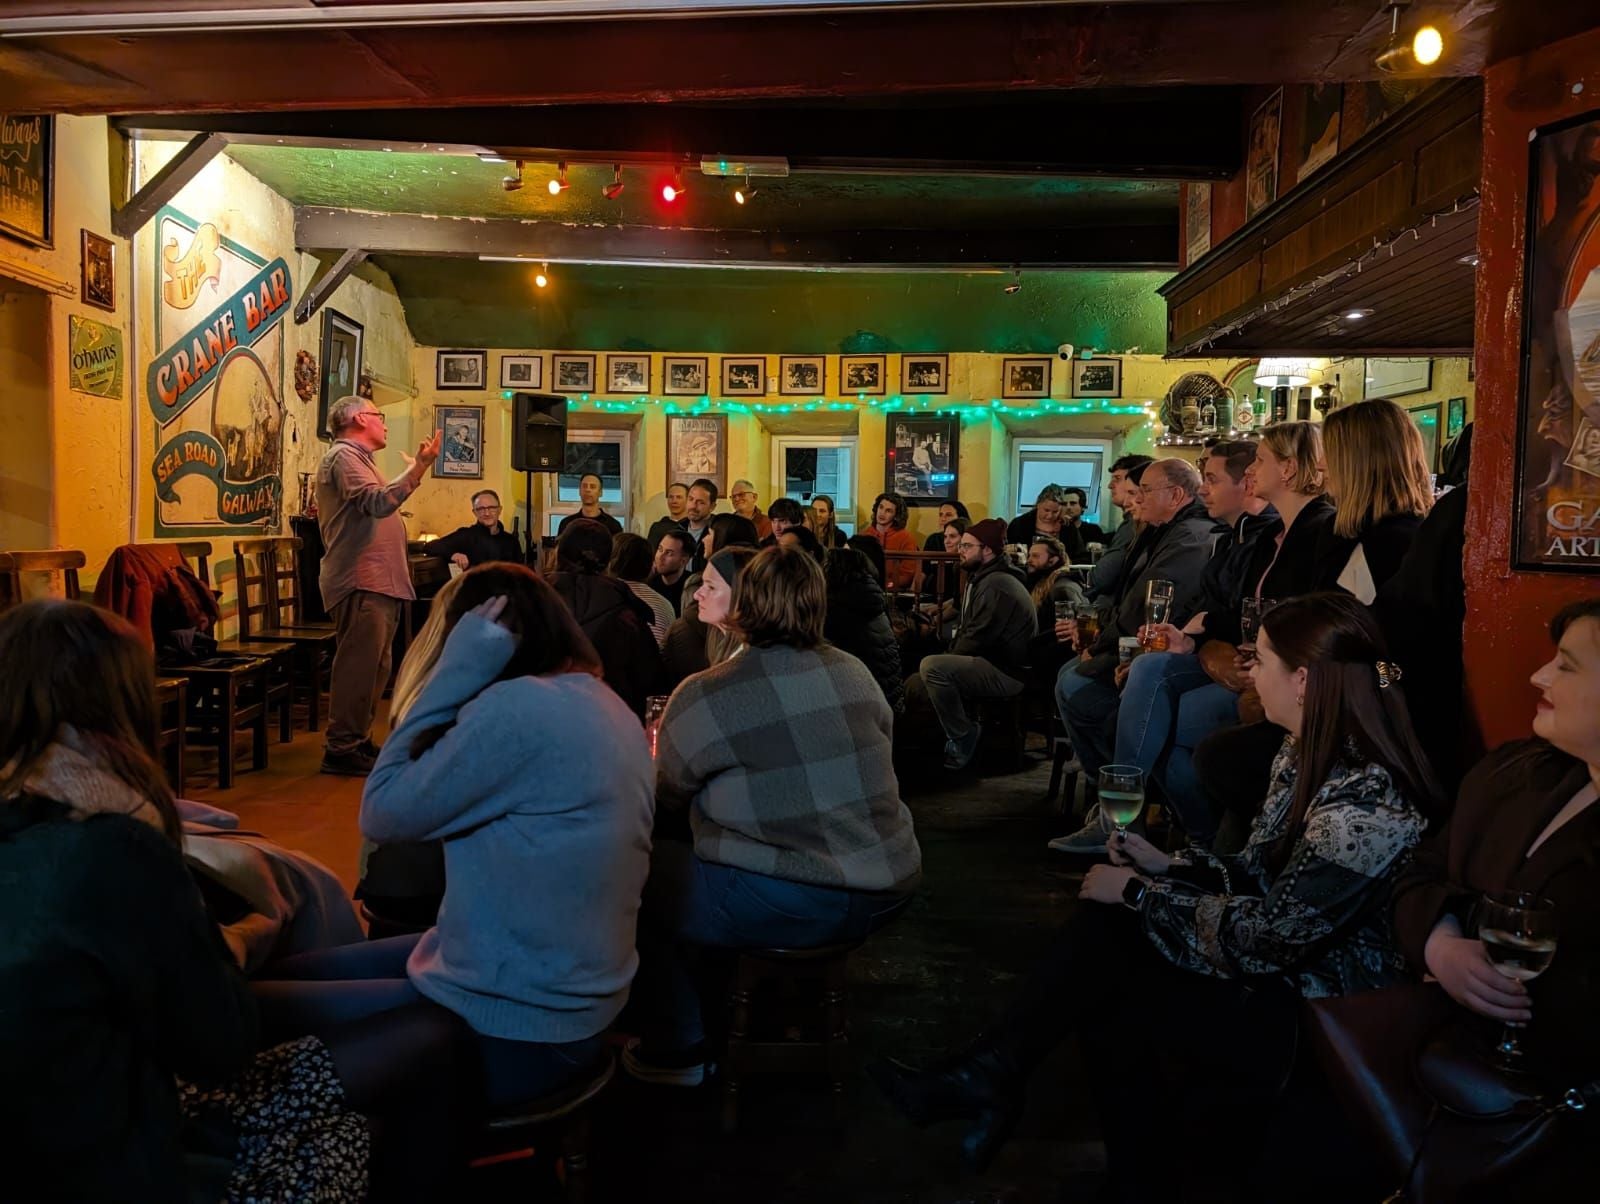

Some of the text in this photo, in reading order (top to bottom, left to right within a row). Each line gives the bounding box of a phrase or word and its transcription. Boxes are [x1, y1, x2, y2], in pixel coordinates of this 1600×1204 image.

[0, 114, 40, 162] lways
[15, 166, 39, 196] TAP
[176, 250, 206, 299] THE
[156, 267, 289, 406] CRANE BAR
[157, 441, 217, 483] SEA ROAD
[222, 483, 274, 516] GALWAY
